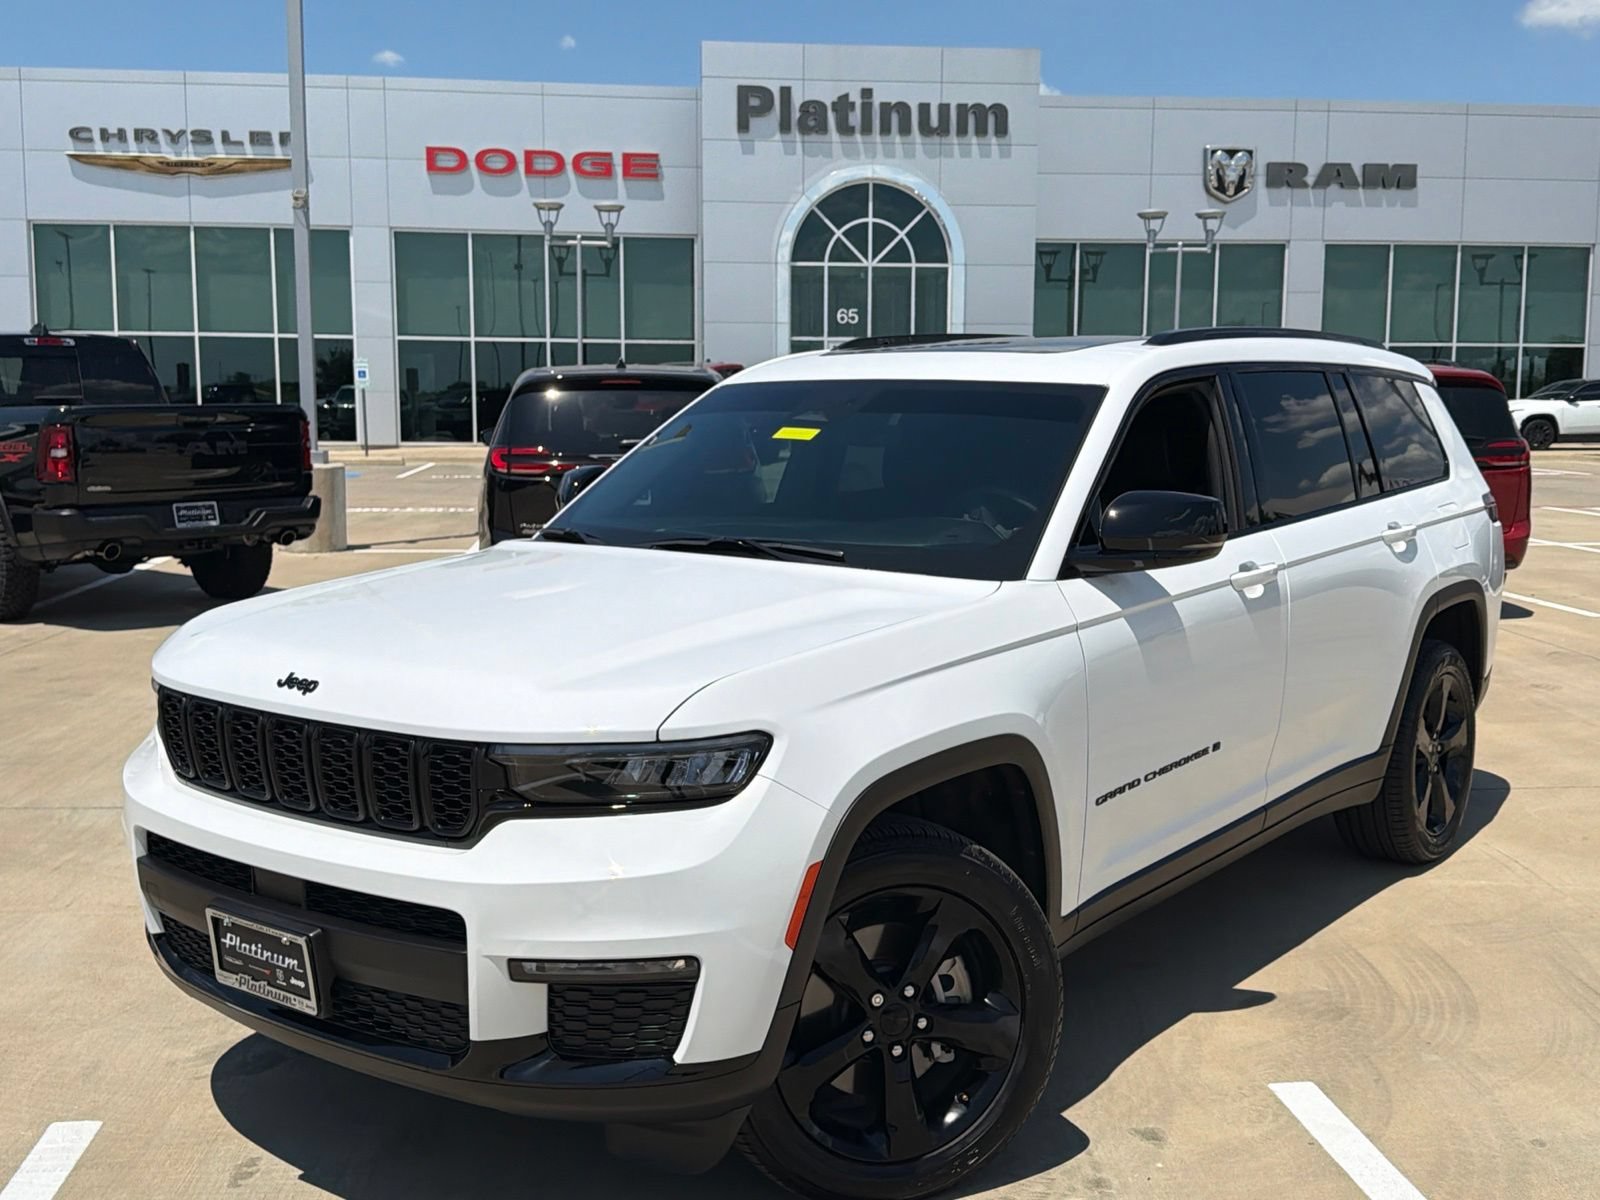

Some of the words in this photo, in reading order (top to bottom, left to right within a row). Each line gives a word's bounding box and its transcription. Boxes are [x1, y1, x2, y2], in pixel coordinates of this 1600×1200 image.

[736, 84, 1009, 138] Platinum
[425, 146, 660, 180] DODGE
[1266, 161, 1418, 190] RAM
[836, 308, 859, 325] 65
[276, 671, 319, 696] Jeep
[1095, 777, 1141, 806] GRAND
[1144, 746, 1210, 783] CHEROKEE
[220, 932, 304, 974] Platinum
[238, 975, 298, 1007] Platinum
